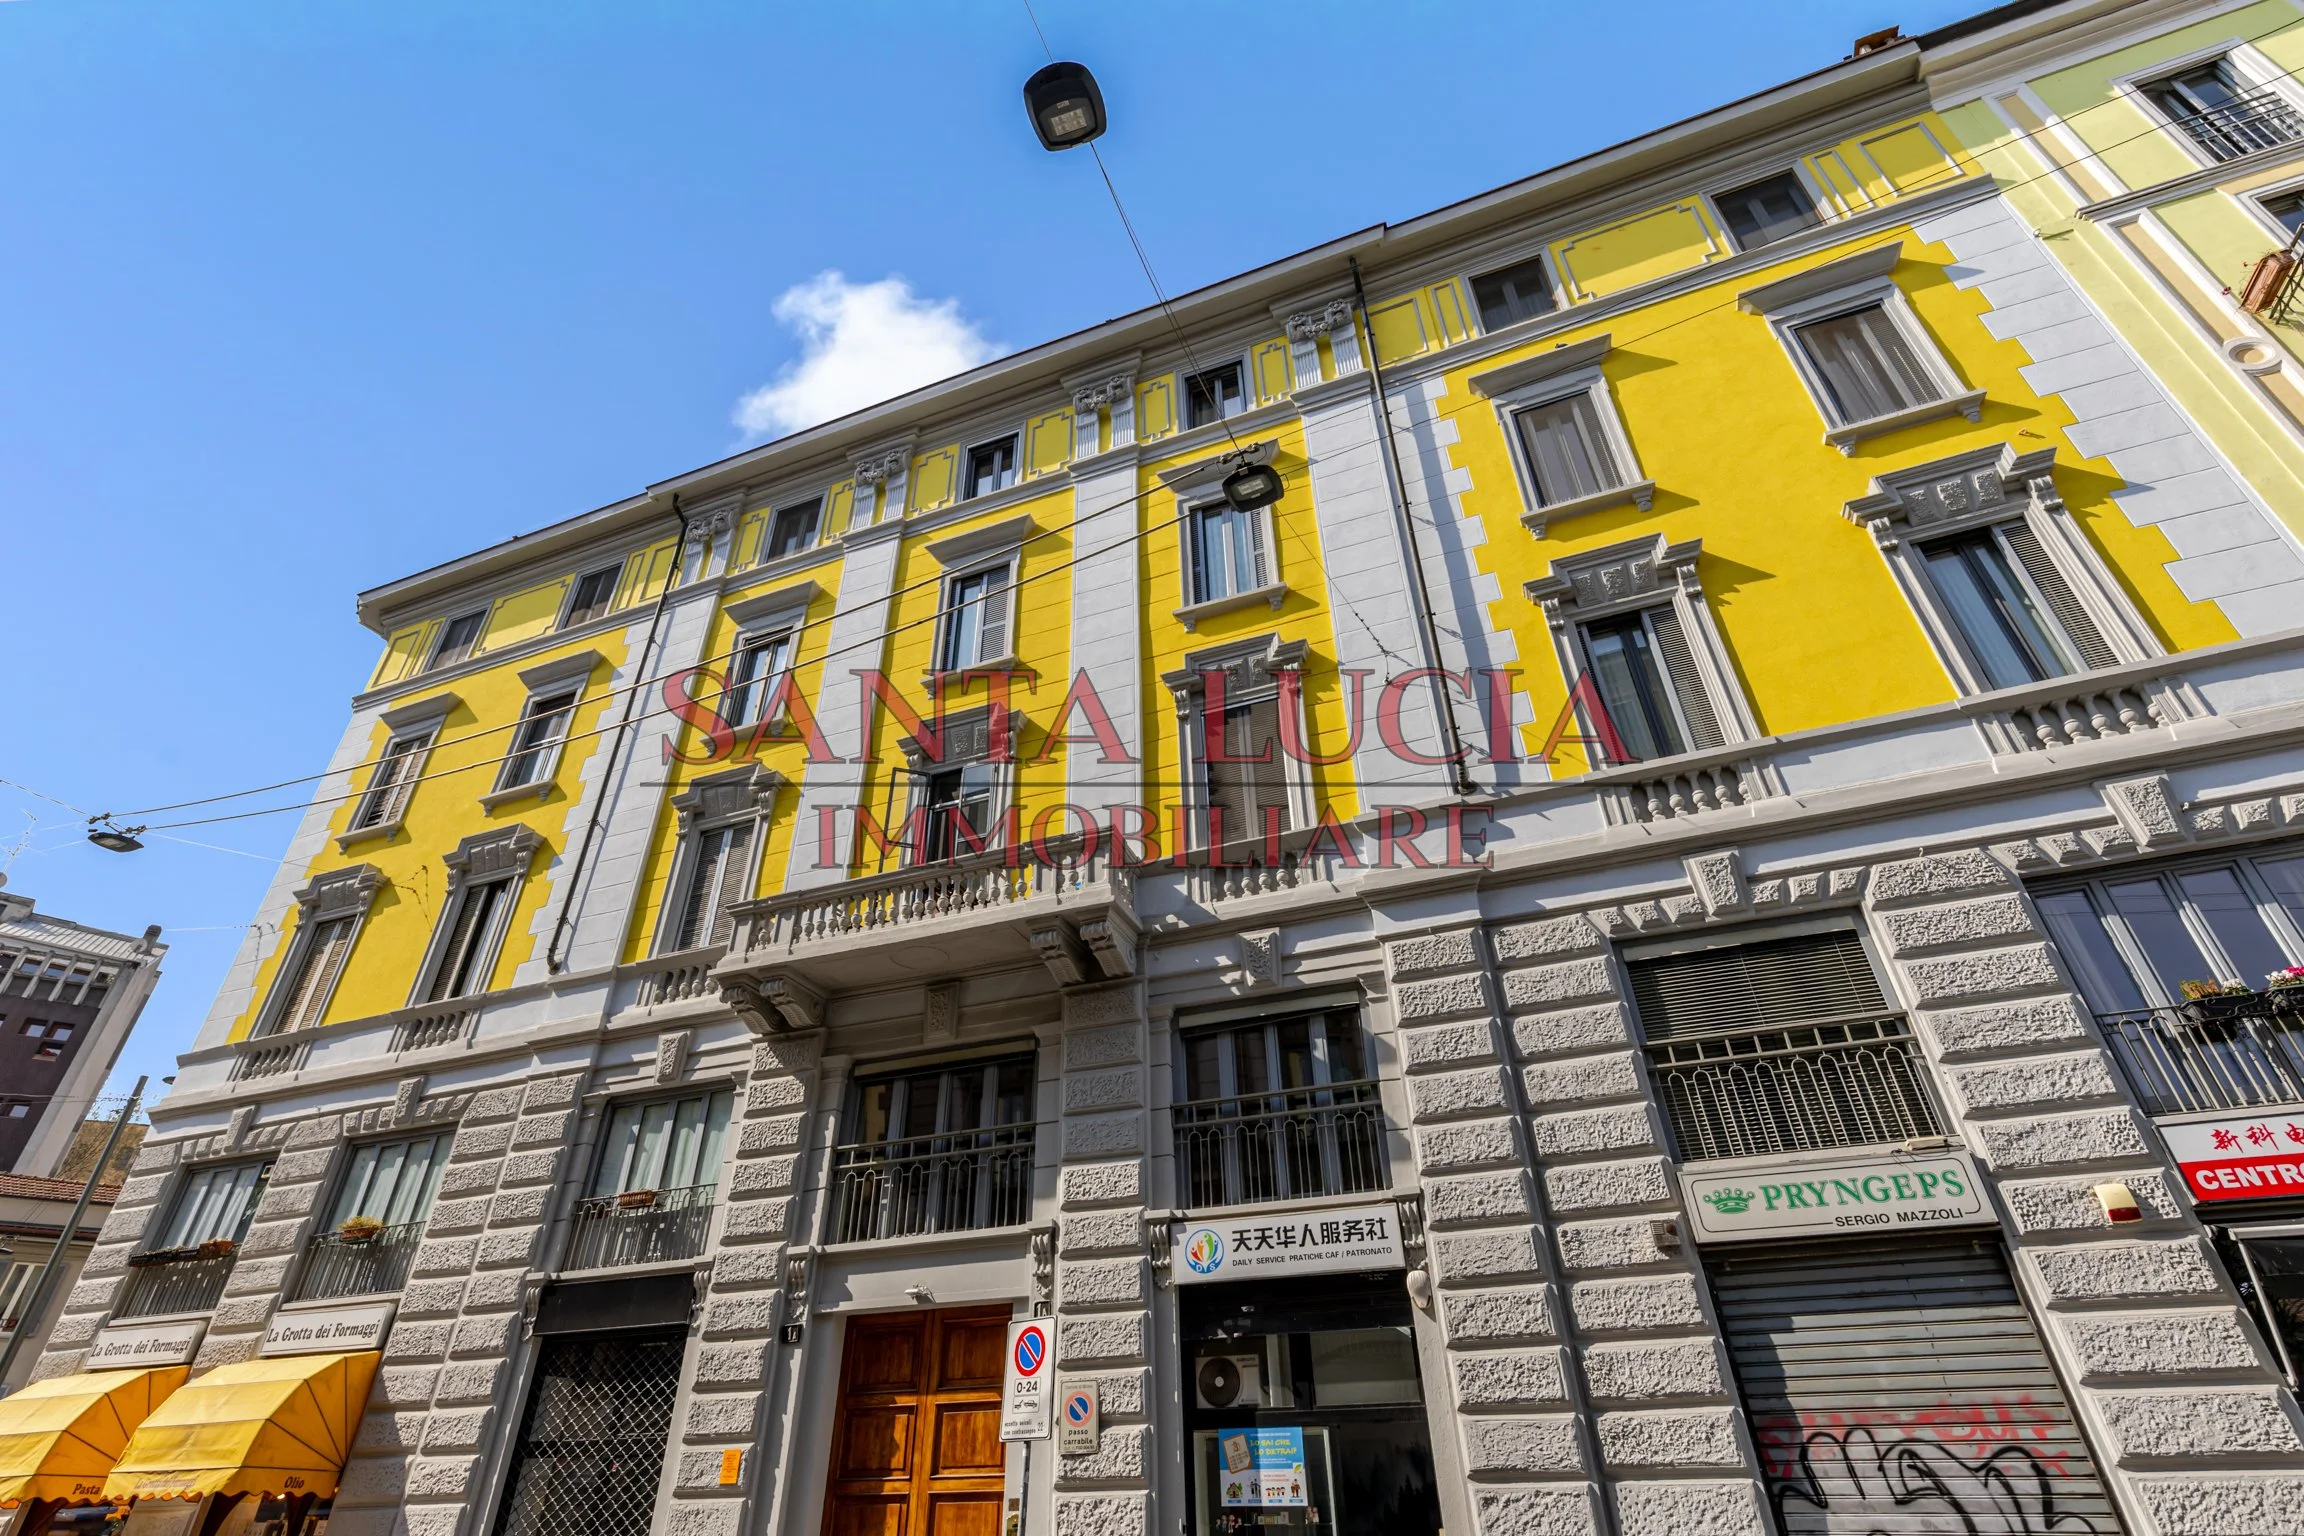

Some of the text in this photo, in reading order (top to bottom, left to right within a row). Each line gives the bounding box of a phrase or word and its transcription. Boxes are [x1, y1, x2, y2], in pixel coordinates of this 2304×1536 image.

[2195, 1163, 2304, 1190] CENTR
[1758, 1167, 1966, 1212] PRYNGEPS
[1834, 1207, 1964, 1228] SERGIO MAZZOLI
[1231, 1216, 1389, 1253] 天天华人服务社
[1232, 1258, 1253, 1268] DAILY
[1256, 1255, 1286, 1265] SERVICE
[1289, 1252, 1325, 1262] PRATICHE
[1325, 1250, 1340, 1260] CAF
[1346, 1246, 1393, 1257] PATRONATO
[266, 1319, 381, 1343] La Grotta dei Formaggi
[90, 1336, 192, 1358] La Grotta dei Formaggi
[1016, 1380, 1038, 1394] 0-24
[1063, 1437, 1093, 1446] carrabile
[1068, 1429, 1089, 1438] passo
[72, 1483, 100, 1496] Pasta
[284, 1476, 304, 1489] Olio
